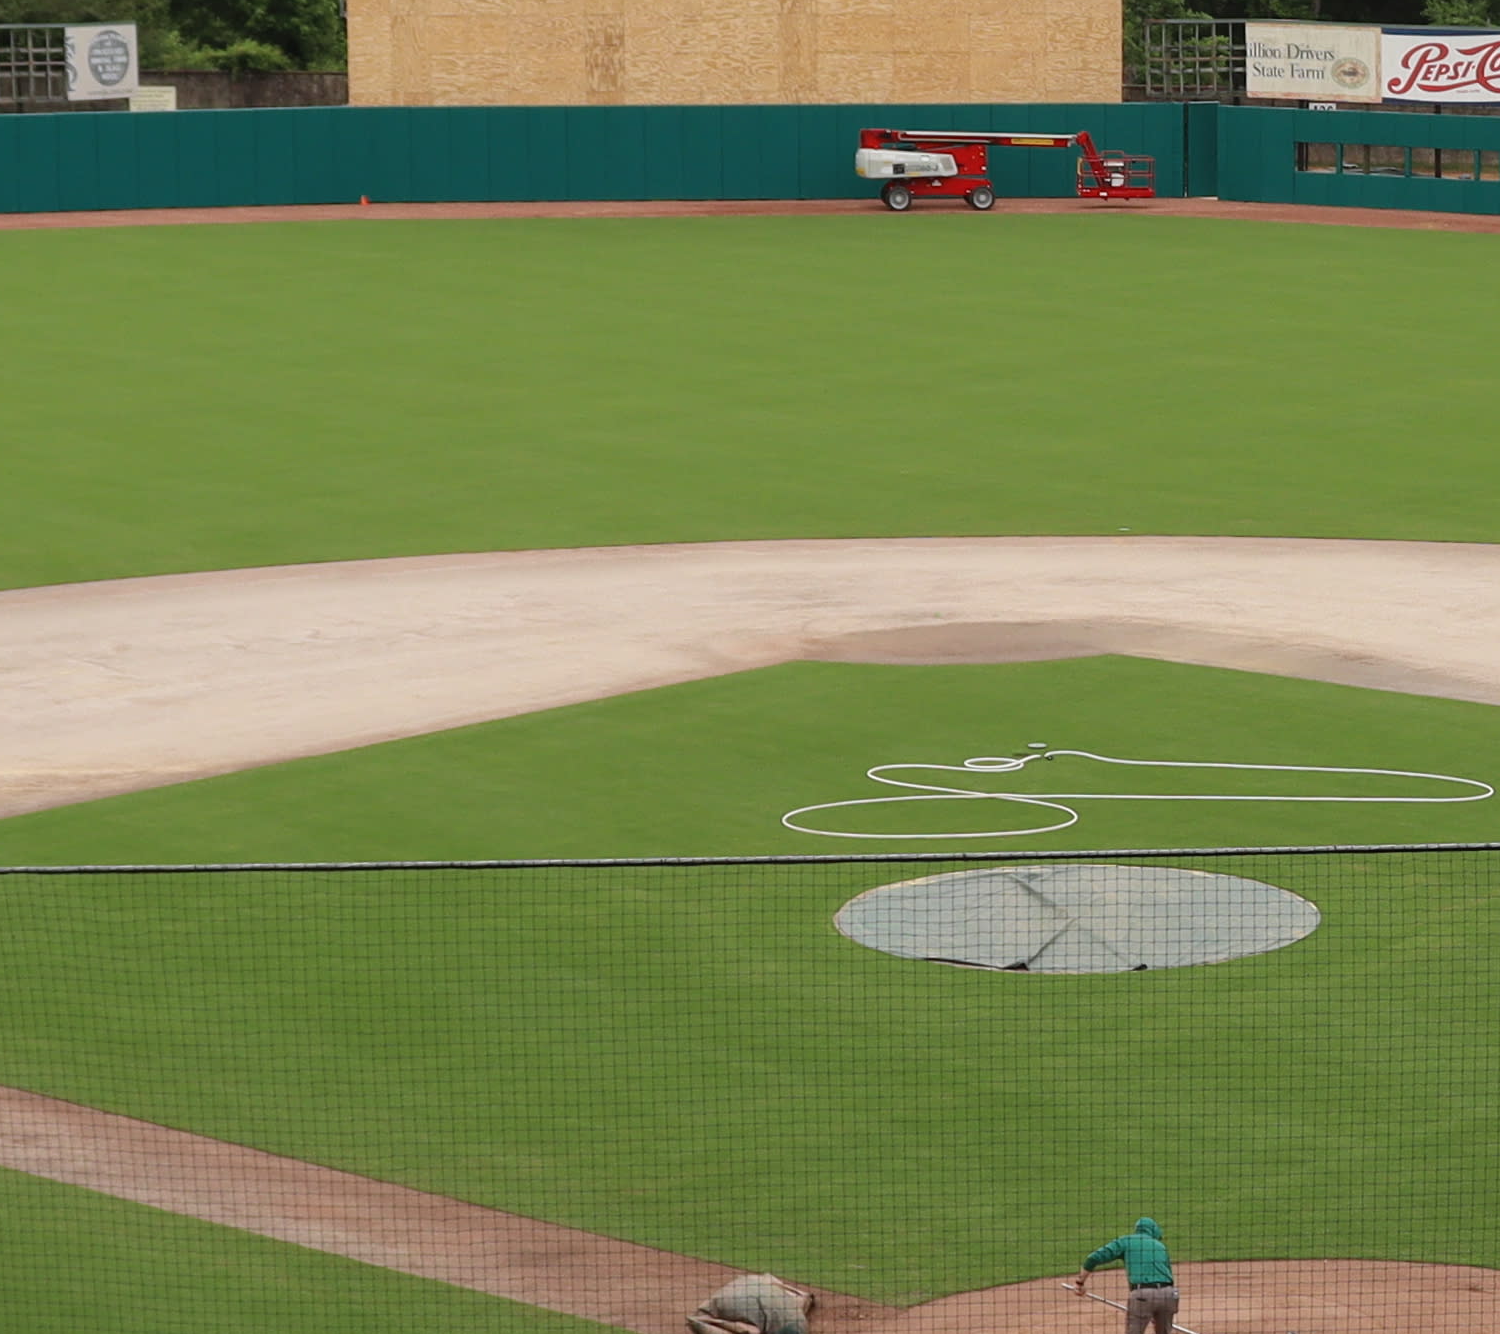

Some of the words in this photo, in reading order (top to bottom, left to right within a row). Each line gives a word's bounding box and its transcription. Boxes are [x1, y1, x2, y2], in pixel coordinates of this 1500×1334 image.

[1287, 43, 1335, 61] Drivers
[1252, 62, 1285, 78] State
[1290, 63, 1325, 80] Farm
